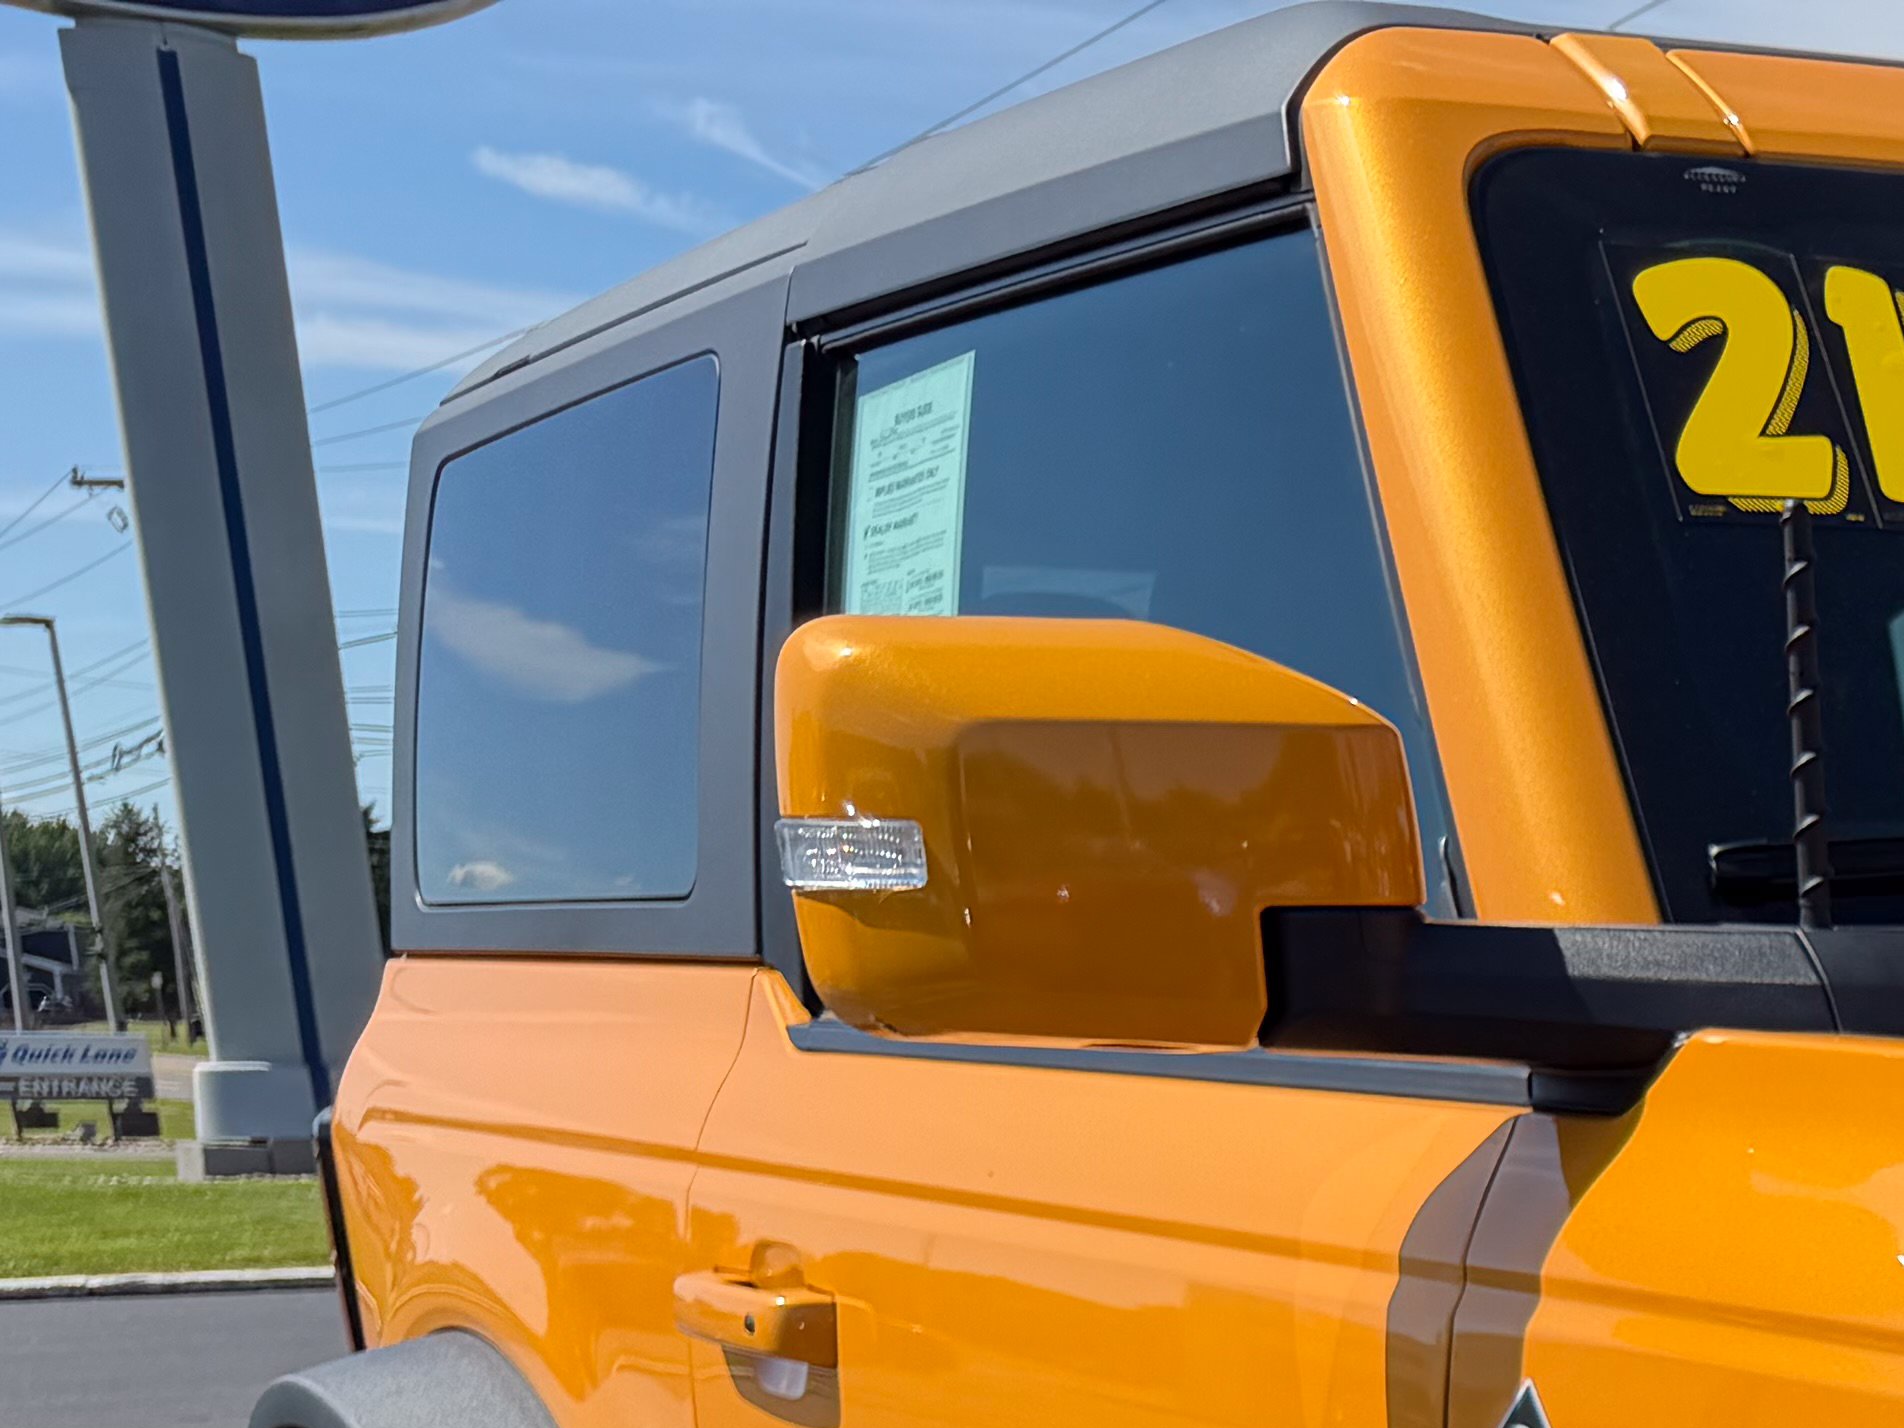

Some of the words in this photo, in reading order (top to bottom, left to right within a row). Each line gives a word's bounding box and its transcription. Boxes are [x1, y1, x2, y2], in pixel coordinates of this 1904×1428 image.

[11, 1042, 76, 1066] Quick
[79, 1043, 138, 1065] Lane
[18, 1077, 139, 1097] ENTRANCE
